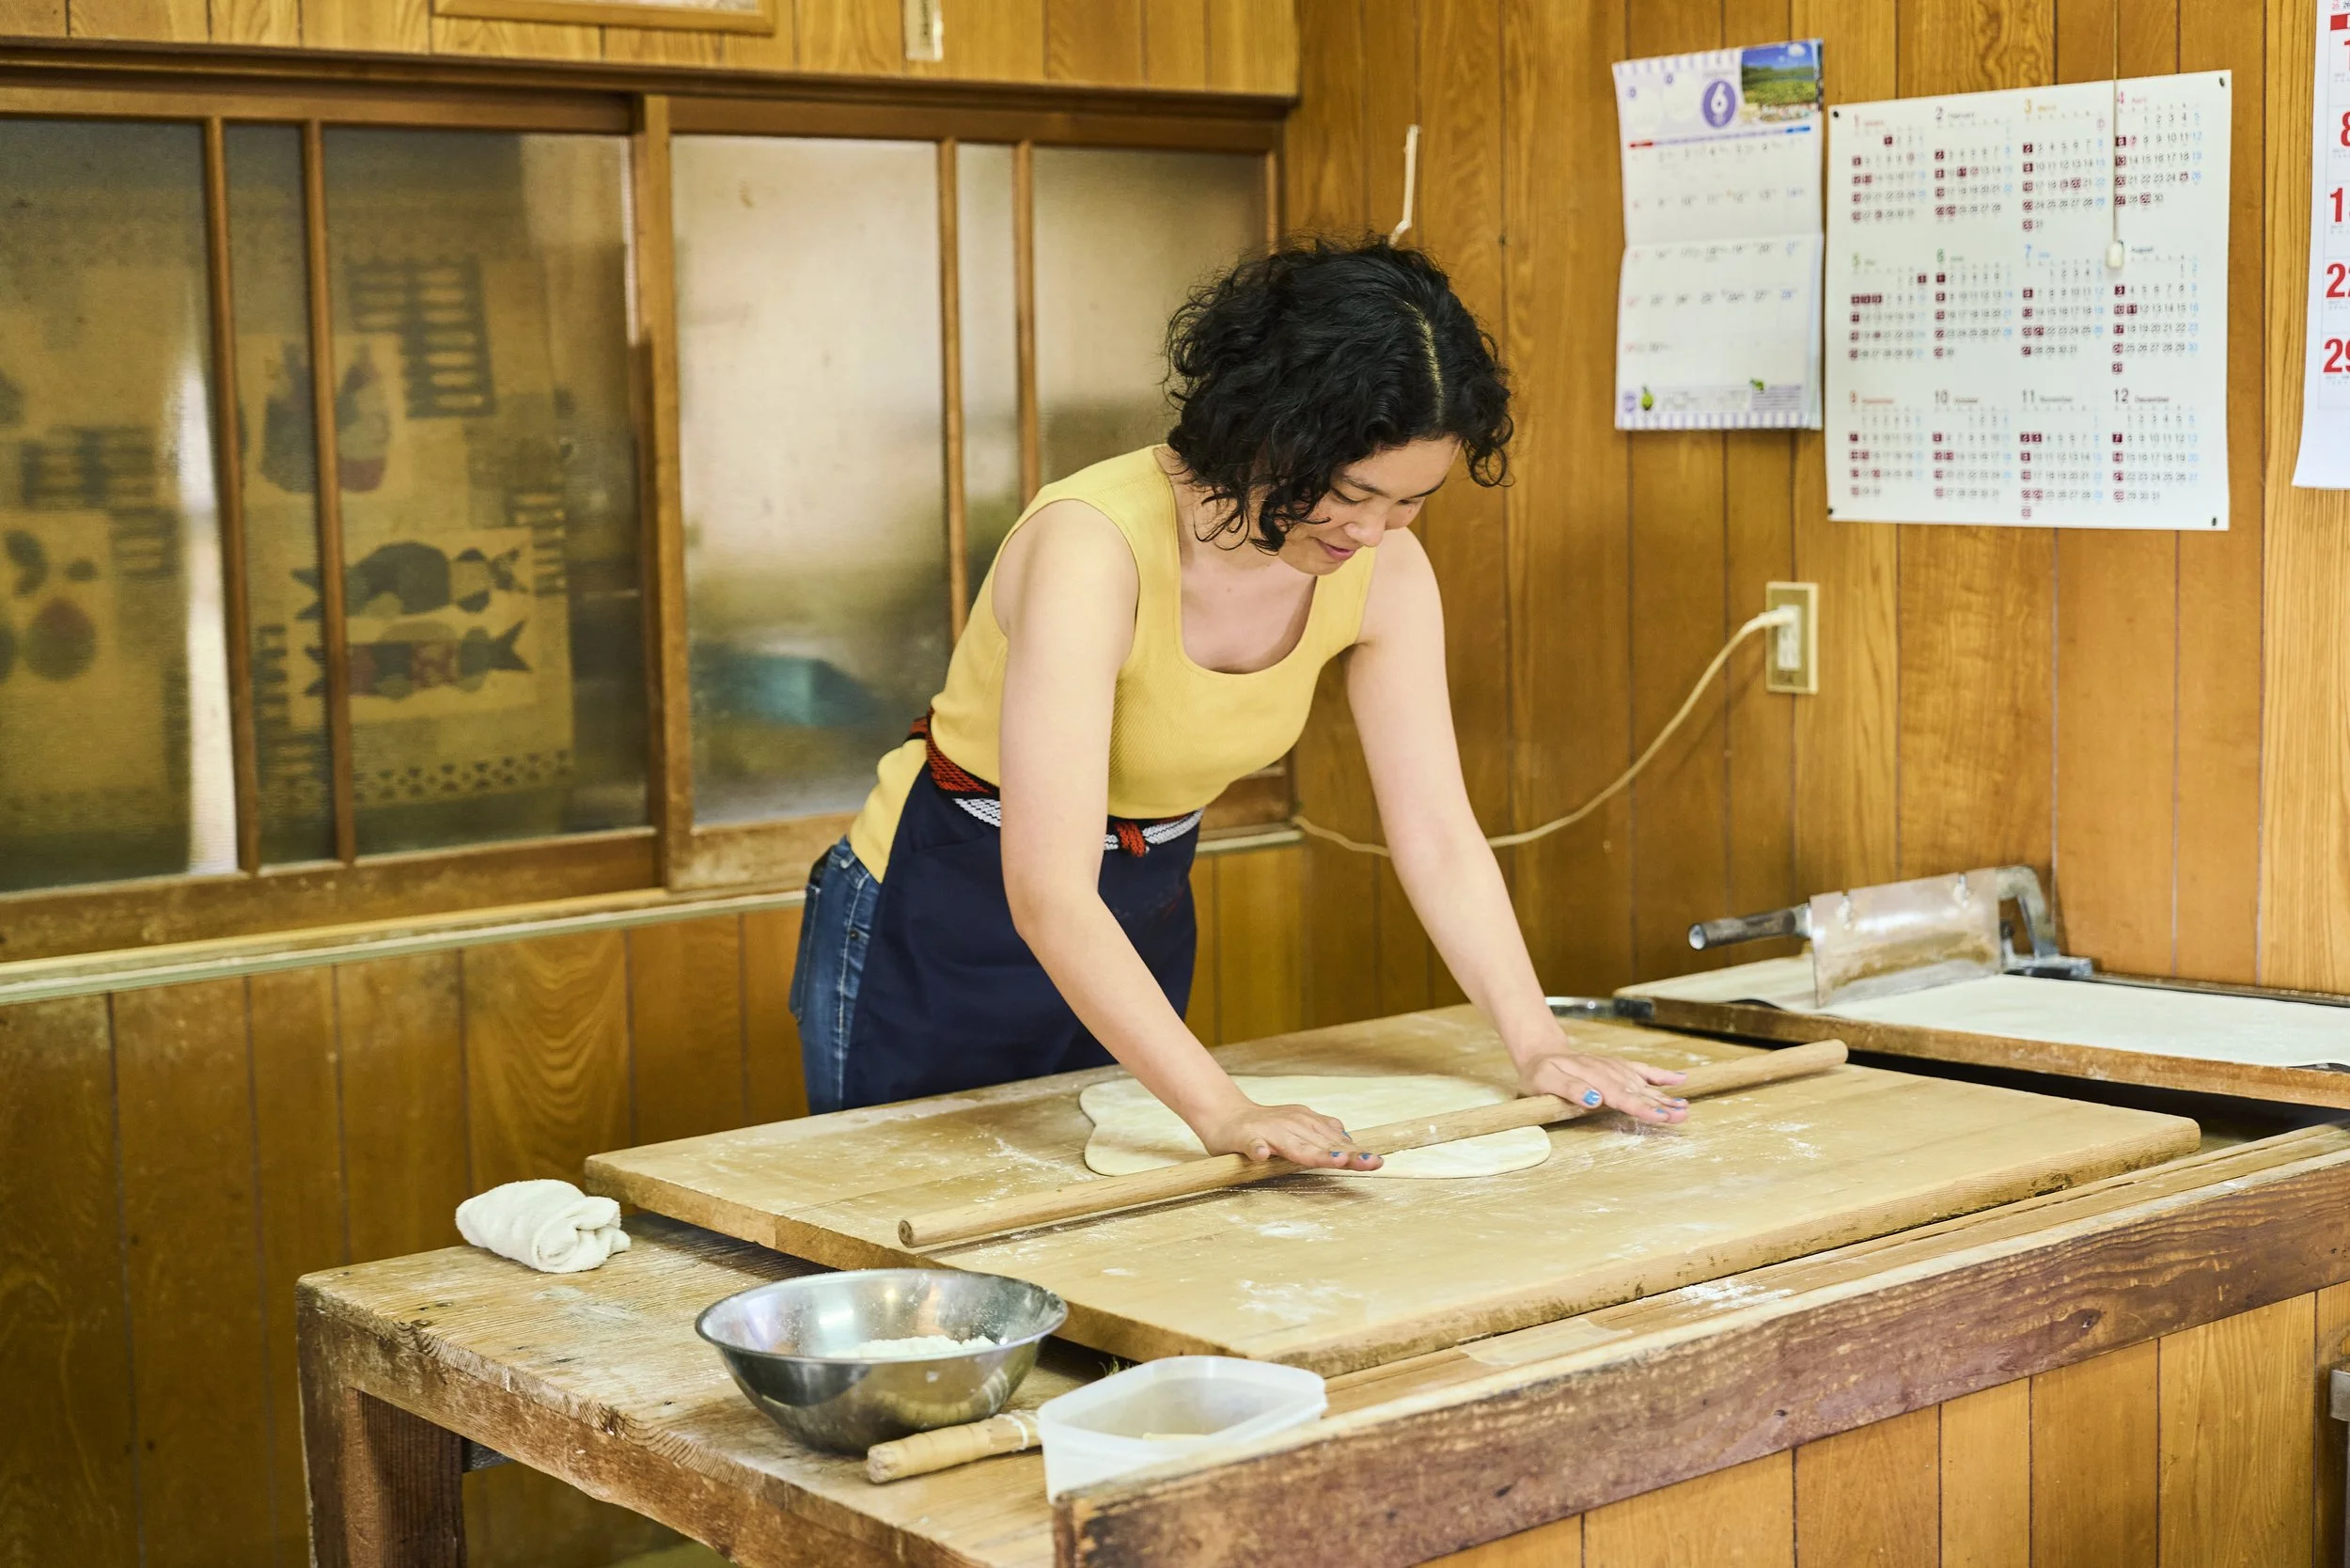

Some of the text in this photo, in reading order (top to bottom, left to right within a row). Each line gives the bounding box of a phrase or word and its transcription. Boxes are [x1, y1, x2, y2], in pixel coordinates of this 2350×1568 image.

[1711, 83, 1728, 114] 6
[2024, 98, 2031, 115] 3
[1935, 106, 1943, 121] 2
[2329, 187, 2350, 224] 1
[2326, 262, 2350, 299] 2
[2323, 337, 2350, 373] 2
[1935, 389, 1948, 405] 10
[2022, 389, 2035, 404] 11
[2113, 387, 2129, 404] 12
